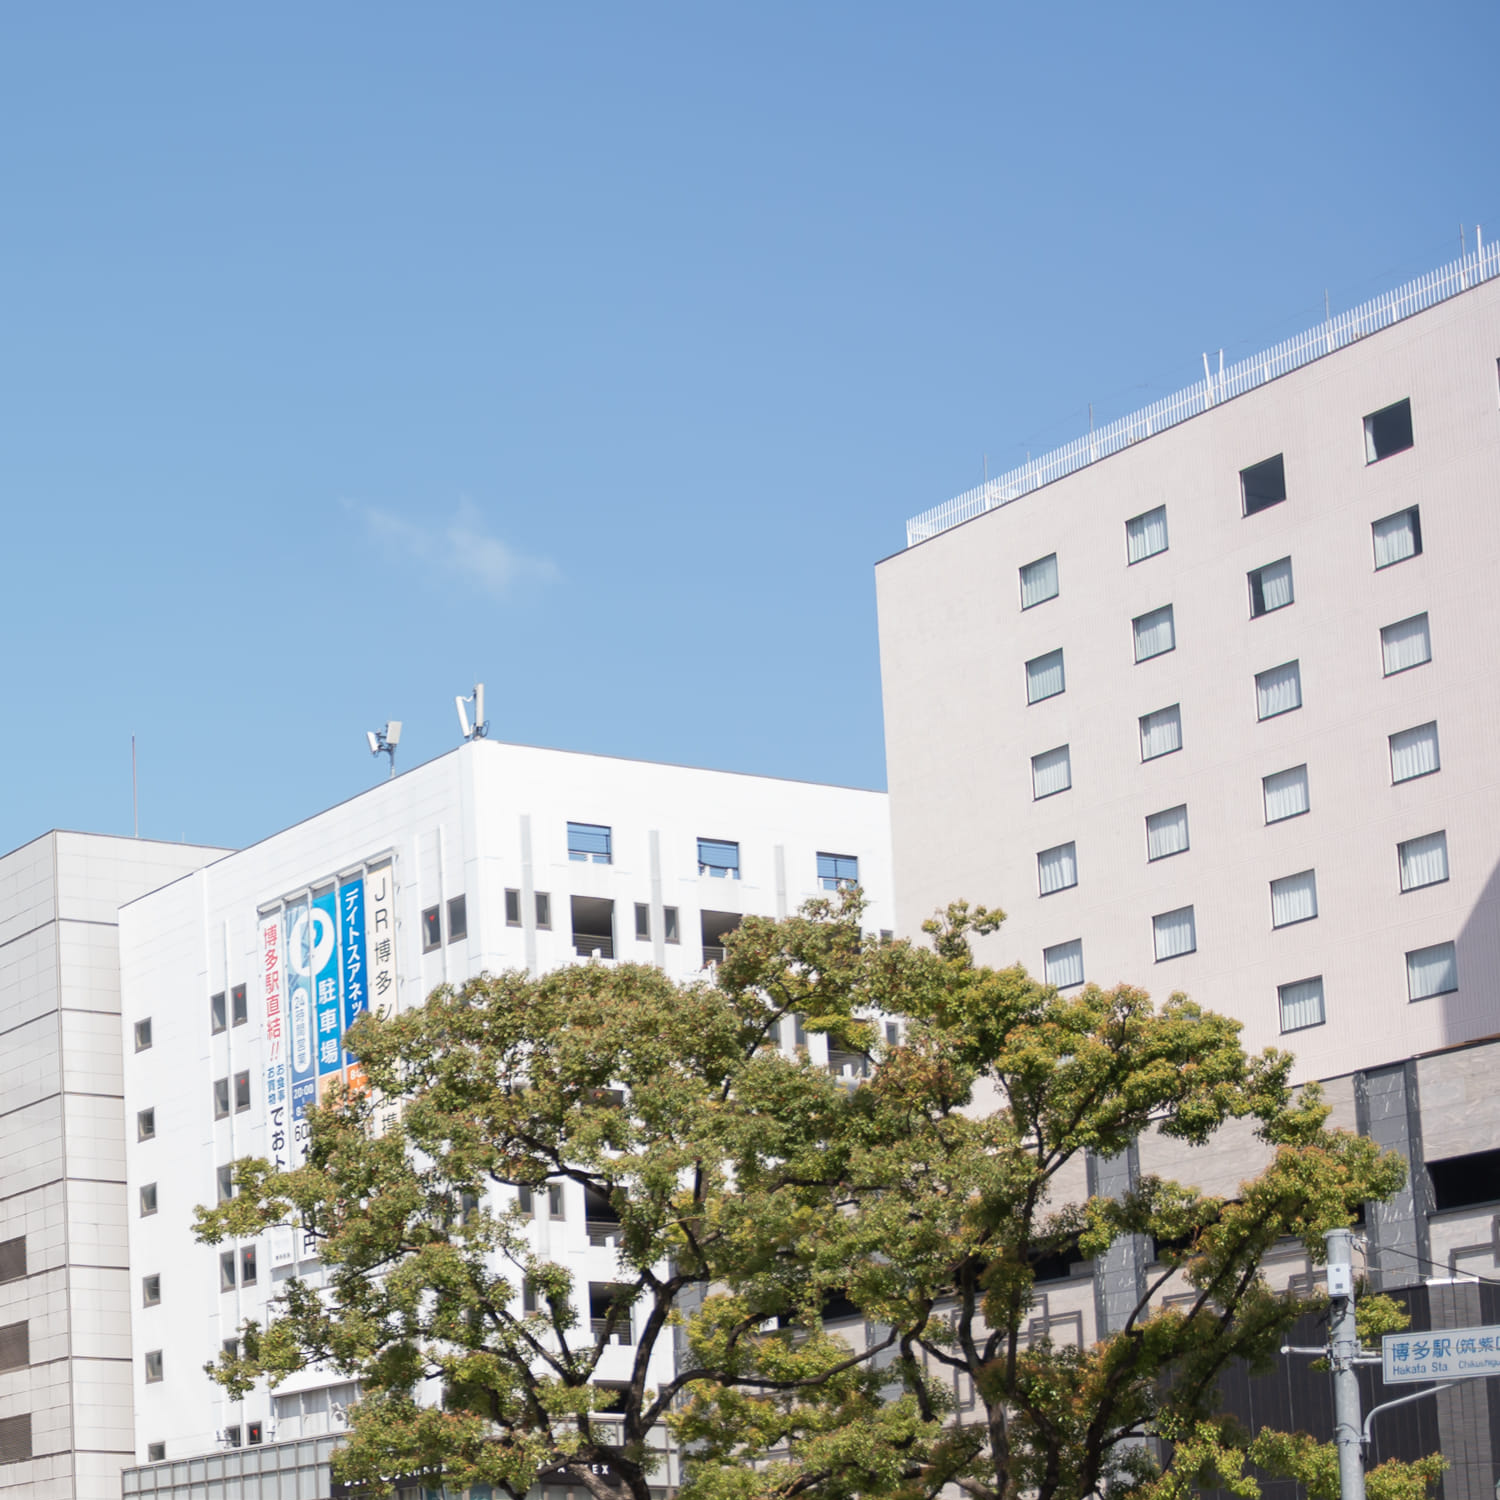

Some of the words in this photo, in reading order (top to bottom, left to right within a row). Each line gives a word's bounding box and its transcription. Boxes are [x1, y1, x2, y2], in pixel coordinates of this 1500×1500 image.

[345, 887, 363, 1021] デイトスアネッ
[317, 977, 338, 1064] 駐車場
[1392, 1336, 1500, 1362] 博多駅(筑紫
[1393, 1363, 1426, 1376] Hakata
